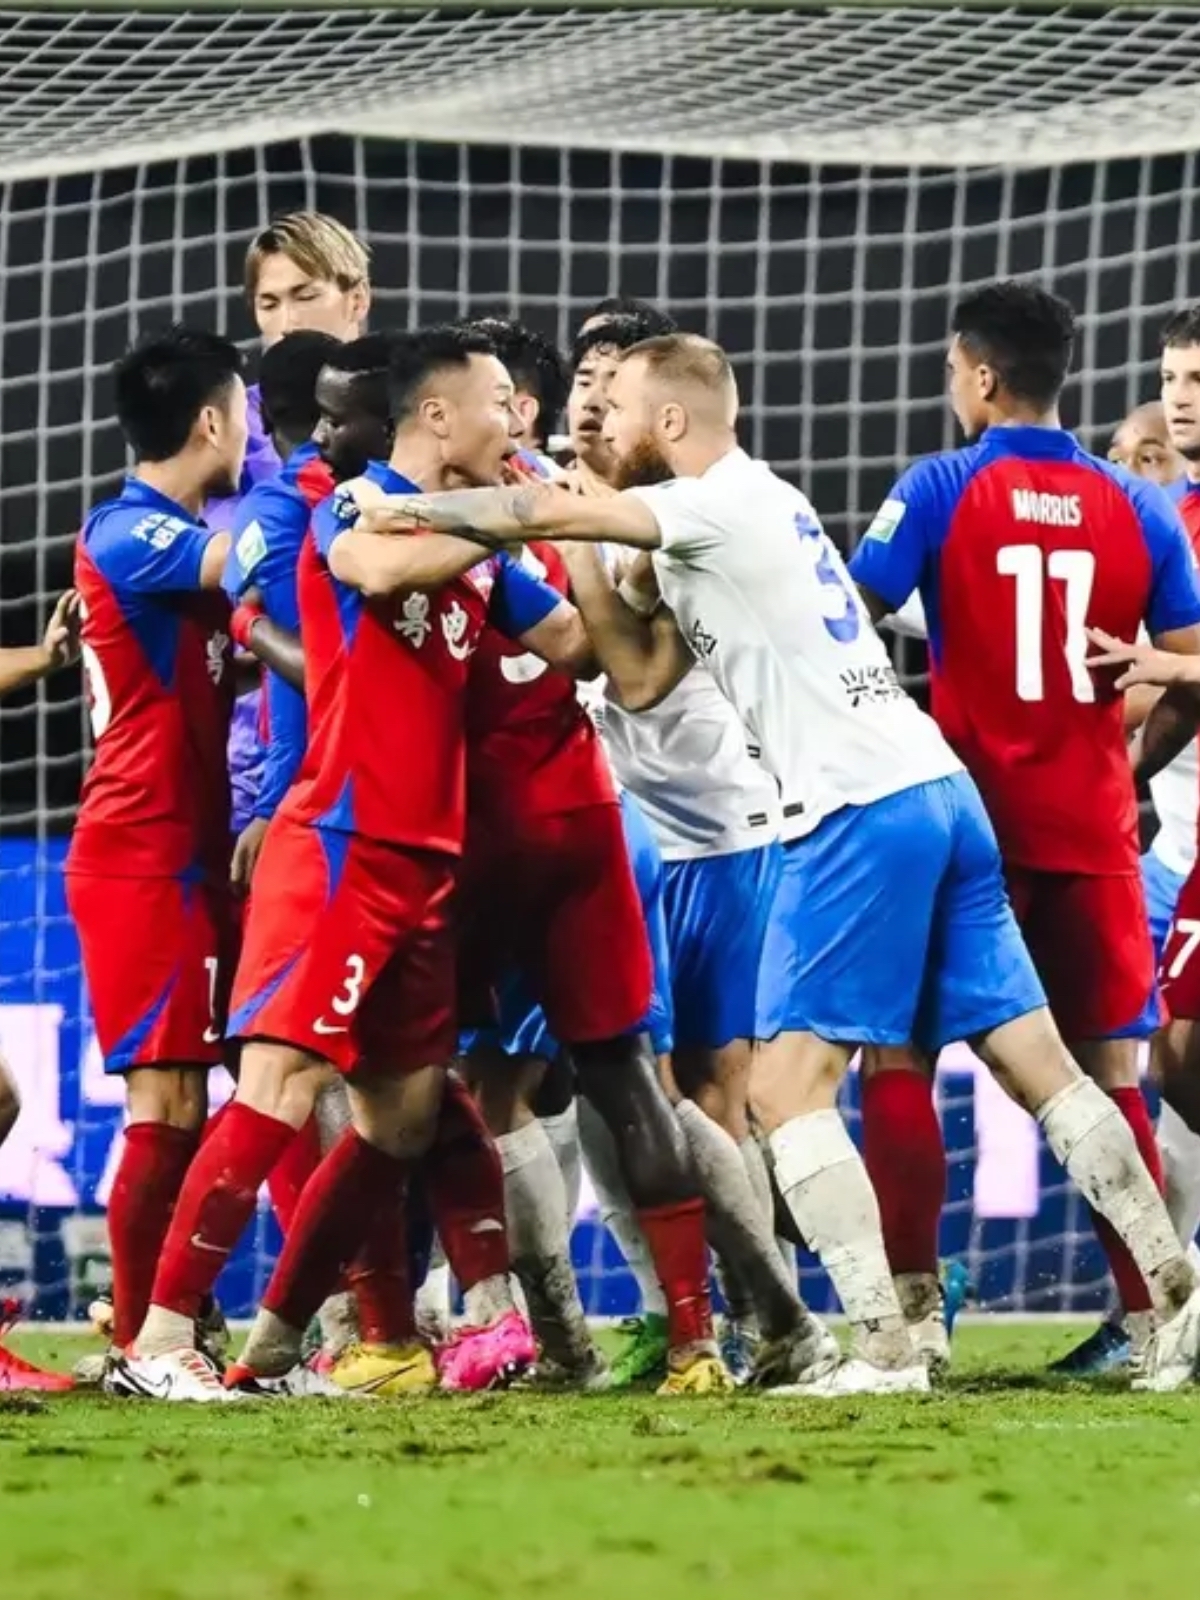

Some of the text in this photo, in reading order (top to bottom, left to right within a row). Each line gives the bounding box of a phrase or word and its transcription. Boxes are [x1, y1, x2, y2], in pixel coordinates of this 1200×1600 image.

[1012, 488, 1083, 527] MORRIS
[393, 591, 478, 661] 粤电
[996, 543, 1096, 705] 11
[1157, 918, 1200, 979] 7
[332, 953, 365, 1016] 3
